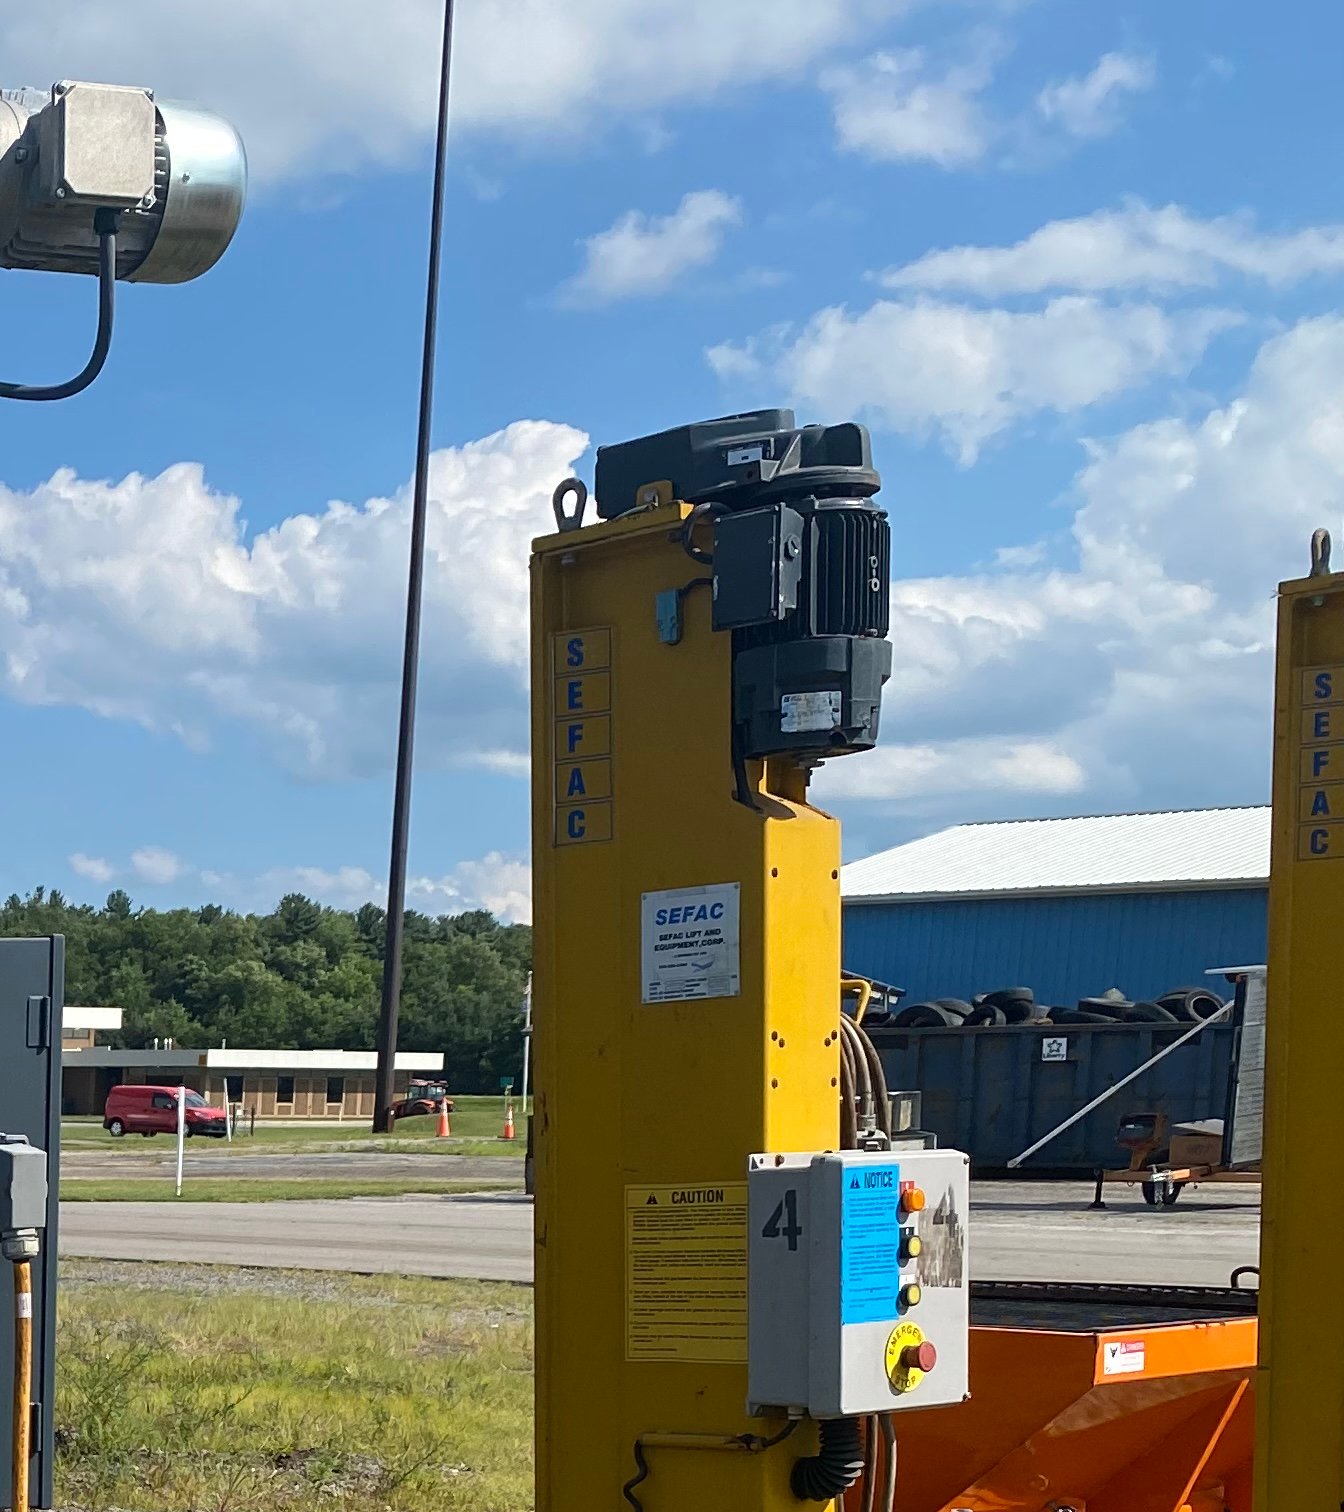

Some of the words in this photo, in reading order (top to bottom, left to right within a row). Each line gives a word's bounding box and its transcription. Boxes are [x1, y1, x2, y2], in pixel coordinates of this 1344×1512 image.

[566, 637, 586, 840] SEFAC
[1310, 672, 1332, 855] SEFAC
[655, 902, 724, 925] SEFAC
[659, 932, 683, 941] SEFAC
[704, 928, 721, 936] AND
[863, 1171, 893, 1189] NOTICE
[671, 1189, 724, 1205] CAUTION
[761, 1189, 803, 1252] 4
[888, 1324, 922, 1356] EMERGEN
[894, 1374, 916, 1388] STOP
